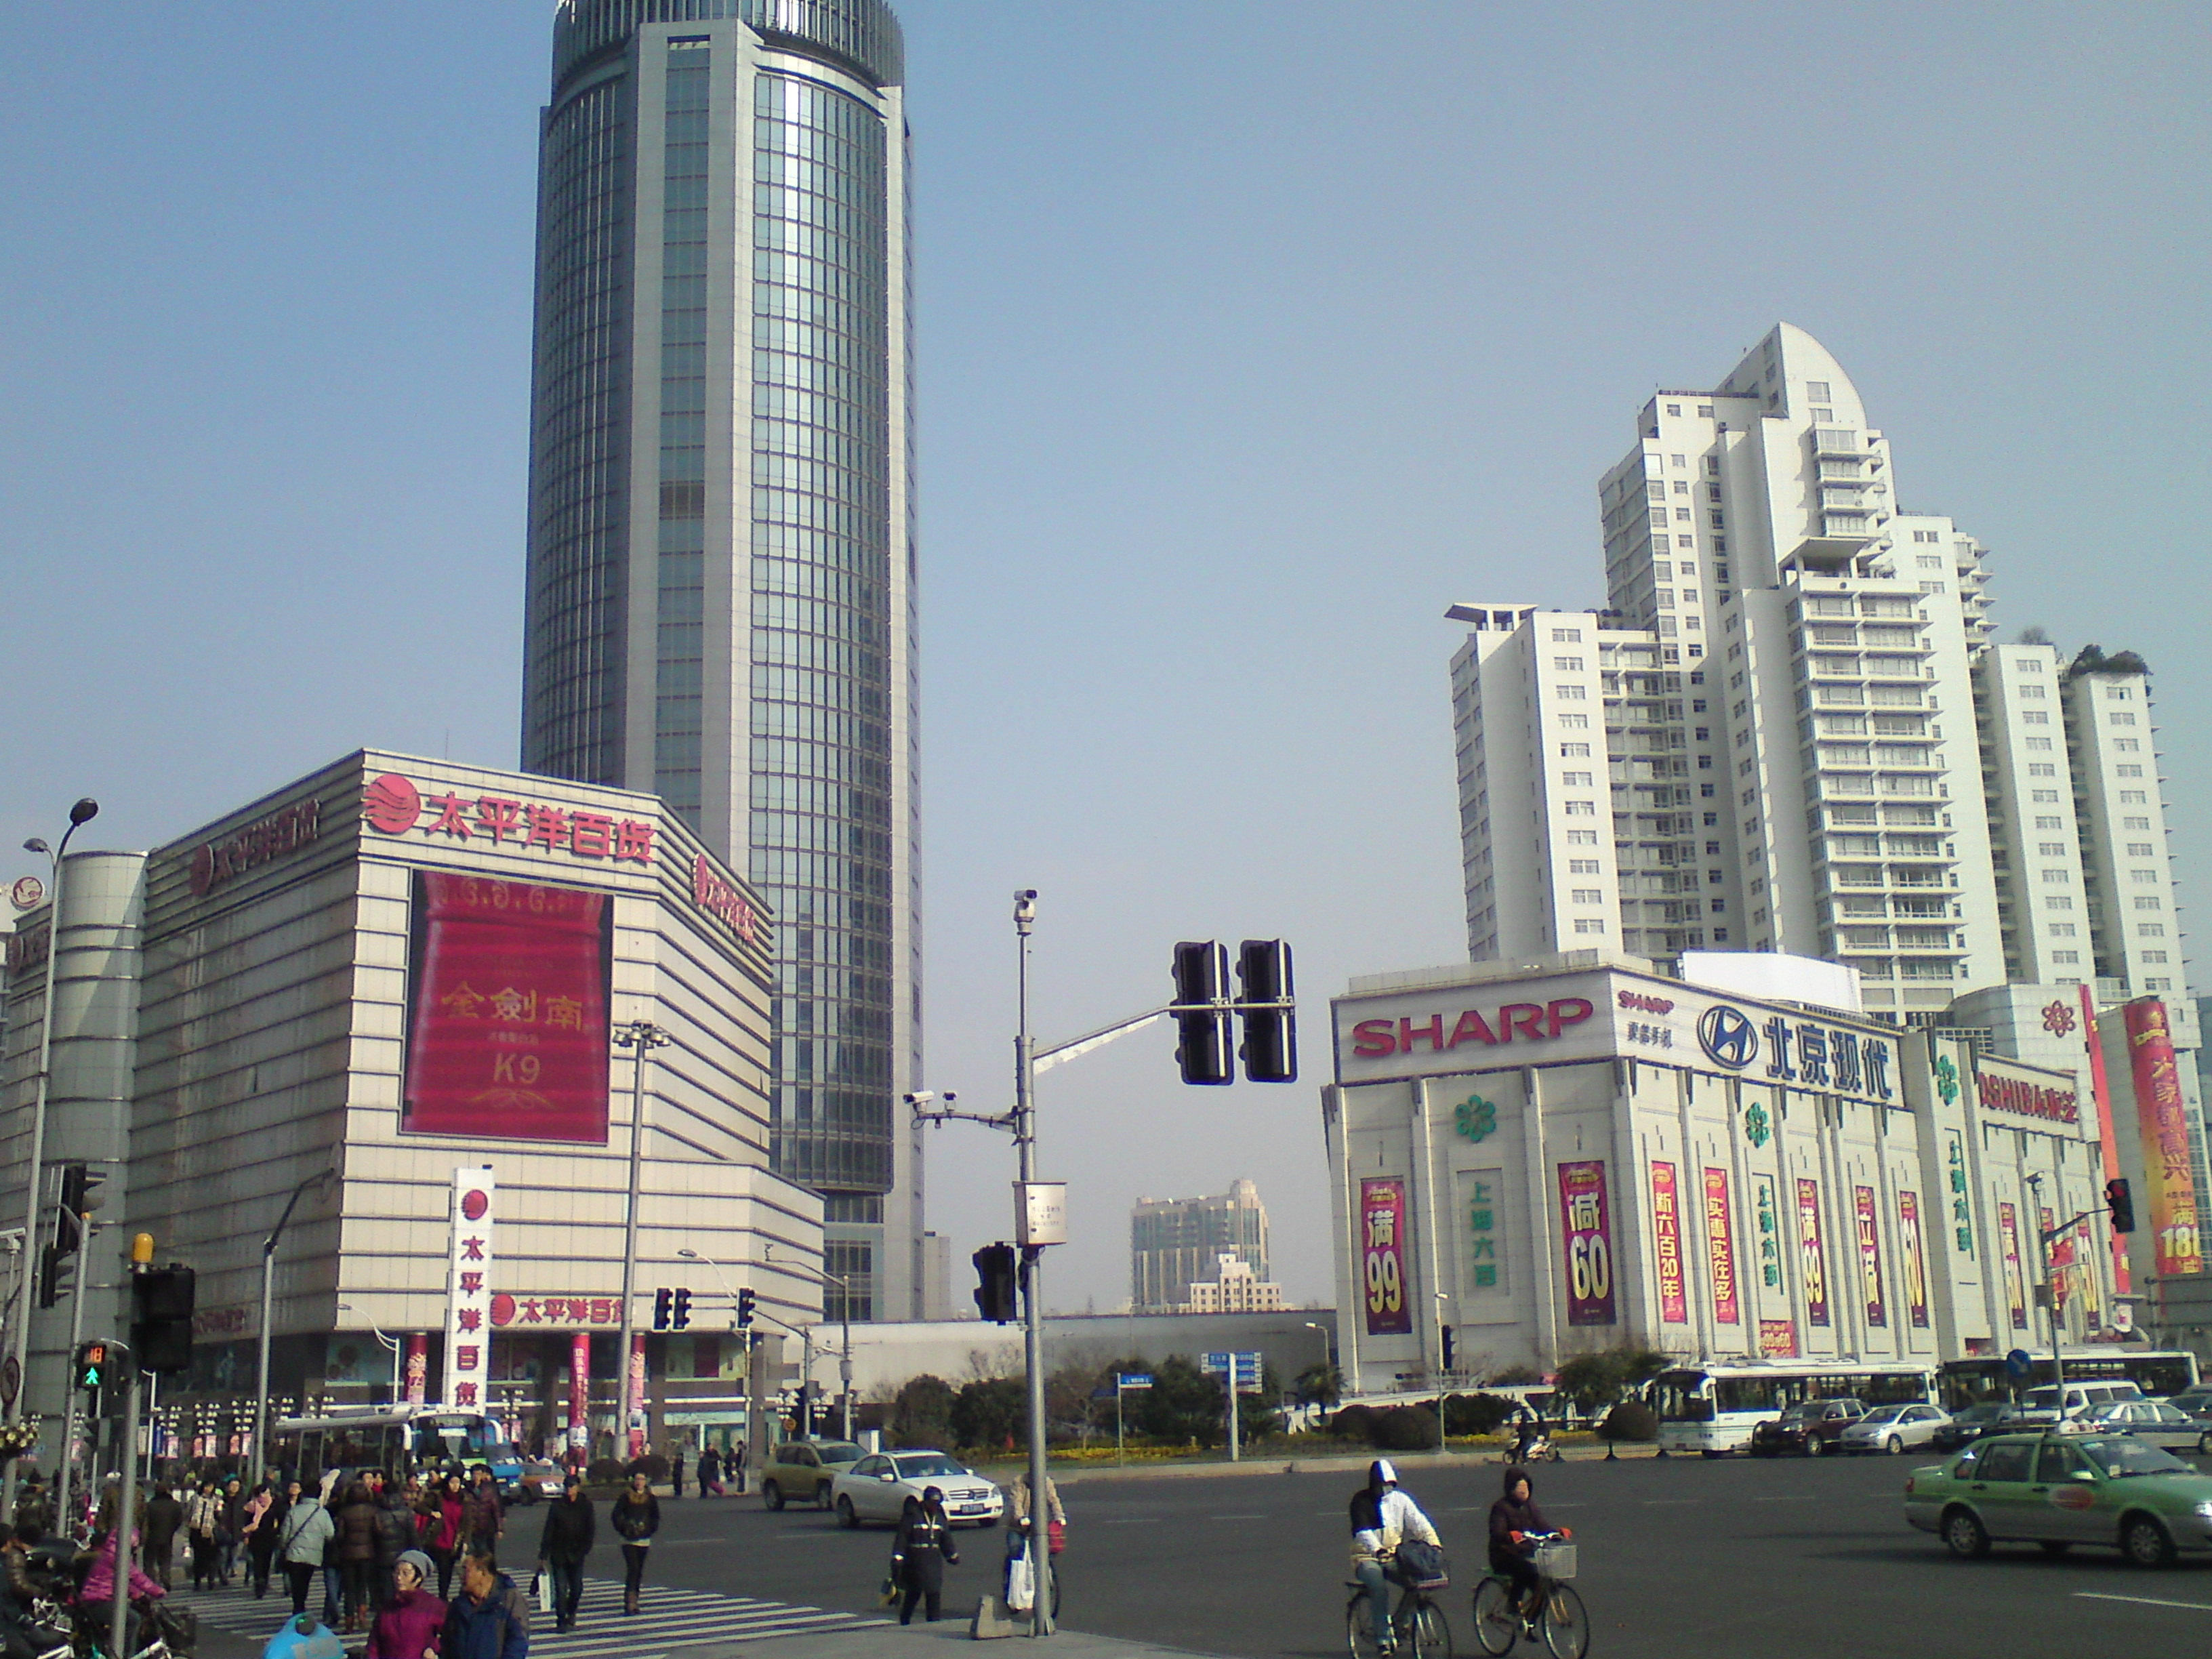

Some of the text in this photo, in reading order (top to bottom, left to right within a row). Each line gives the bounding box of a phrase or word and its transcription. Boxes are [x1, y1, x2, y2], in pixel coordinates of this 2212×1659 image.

[428, 791, 655, 863] 太平洋百货
[1352, 997, 1595, 1057] SHARP
[1618, 989, 1675, 1016] SHARP
[493, 1052, 541, 1084] K9
[1762, 1015, 1893, 1100] 北京现代
[1978, 1071, 2042, 1119] OSHIBA
[1367, 1210, 1395, 1248] 满
[1568, 1191, 1600, 1232] 减
[1570, 1233, 1610, 1300] 60
[1656, 1191, 1680, 1299] 新六百20年
[1708, 1196, 1732, 1301] 实惠实在多
[1368, 1250, 1401, 1314] 99
[451, 1235, 487, 1408] 太平洋百货
